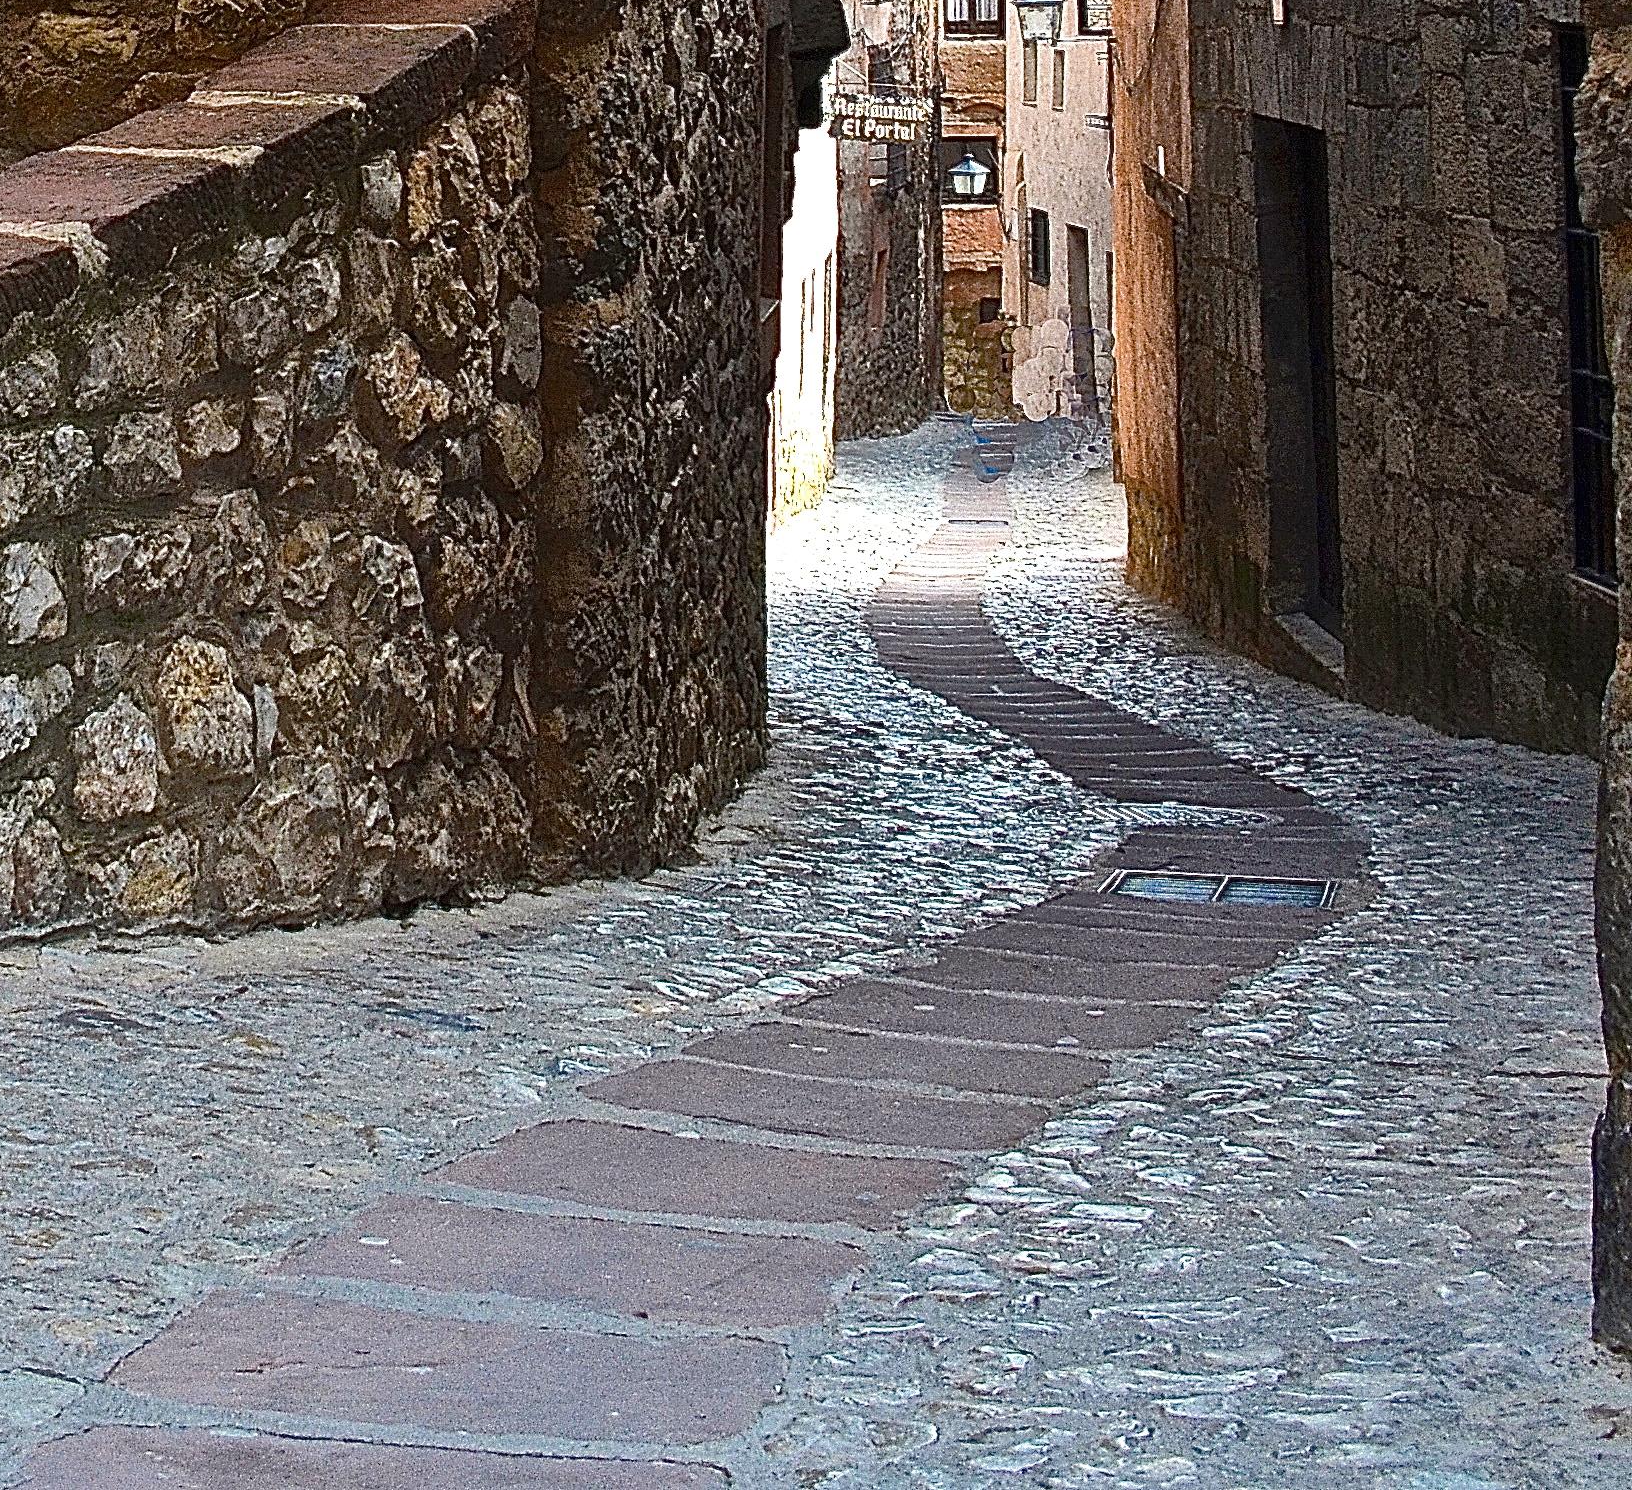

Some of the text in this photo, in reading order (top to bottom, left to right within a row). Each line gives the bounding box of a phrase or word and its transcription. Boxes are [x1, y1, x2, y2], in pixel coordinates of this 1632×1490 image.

[833, 97, 927, 121] Restaurante
[842, 118, 917, 140] El Portal
